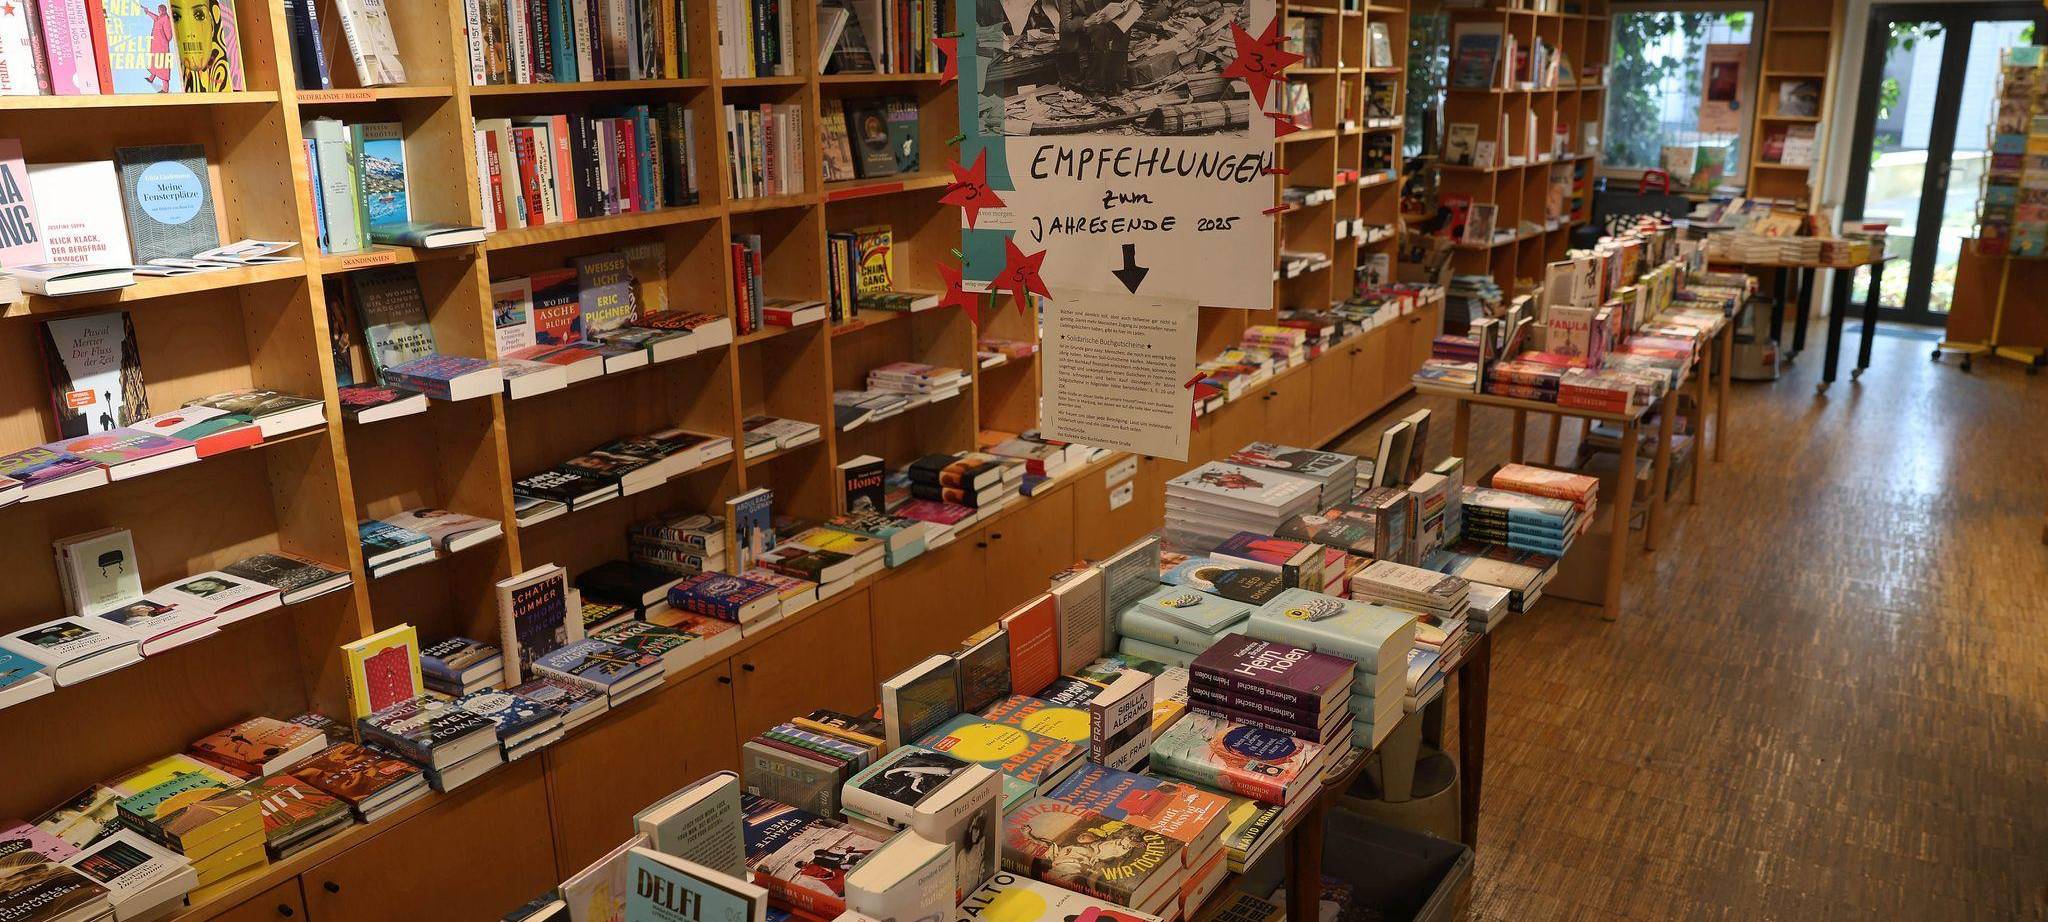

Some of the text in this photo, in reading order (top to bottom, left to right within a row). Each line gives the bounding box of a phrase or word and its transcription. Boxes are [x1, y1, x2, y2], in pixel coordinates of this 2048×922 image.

[345, 91, 372, 100] BELGIEN
[1030, 143, 1273, 184] EMPFEHLUNGEN
[0, 163, 24, 205] A
[157, 183, 183, 192] Meine
[143, 190, 199, 203] Fensterplätze
[1103, 189, 1153, 210] zum
[1030, 215, 1241, 244] JAHRESENDE 2025
[49, 237, 73, 246] KLICK
[51, 243, 107, 256] DER BERGFRAU
[342, 255, 390, 267] SKANDINAVIEN
[584, 259, 625, 275] WEISSES
[861, 263, 885, 275] CHAIN
[592, 275, 619, 288] LICHT
[862, 274, 886, 286] GANG
[384, 294, 419, 306] JUNGES
[385, 287, 418, 298] WOHNT
[543, 296, 570, 307] WO DIE
[596, 293, 618, 305] ERIC
[392, 310, 404, 318] IN
[540, 304, 576, 321] ASCHE
[585, 304, 631, 323] PUCHNER
[83, 325, 110, 339] Pascal
[545, 317, 572, 329] BLÜHT
[72, 336, 104, 349] Mercier
[376, 333, 424, 348] DAS NICHT
[393, 338, 432, 351] STERBEN
[411, 345, 433, 354] WILL
[71, 348, 88, 359] Der
[83, 354, 115, 367] der Zeit
[847, 474, 882, 492] Honey
[748, 499, 773, 515] GURNAH
[512, 573, 564, 607] SCHATTEN
[513, 590, 556, 618] NUMMER
[419, 638, 463, 658] Kinder
[432, 642, 466, 658] spiel
[1234, 649, 1282, 677] Heim
[1268, 648, 1309, 676] holen
[1194, 670, 1298, 704] Katherina Braschel Heim holen
[1117, 693, 1145, 716] SIBILLA
[1192, 687, 1296, 720] Katherina Braschel Heim holen
[434, 710, 475, 728] WELT
[1112, 701, 1148, 730] ALERAMO
[1192, 705, 1298, 737] Katherina Braschel Heim holen
[433, 716, 487, 740] ROMAN
[1092, 711, 1102, 741] FRAU
[1002, 735, 1056, 772] ABBAS
[1129, 738, 1147, 759] FRAU
[136, 778, 210, 812] KLAPPER
[952, 786, 991, 817] Patti Smith
[1149, 807, 1180, 831] Sandi
[1156, 803, 1197, 833] Toksvig
[755, 816, 803, 850] ERZÄHLTE
[765, 818, 791, 839] WELT
[1238, 821, 1258, 850] NAVID
[1100, 832, 1165, 882] WIR TÖCHTER
[0, 883, 82, 922] ICHTUNGEN
[636, 867, 702, 922] DELFI
[955, 873, 1016, 922] ALTO
